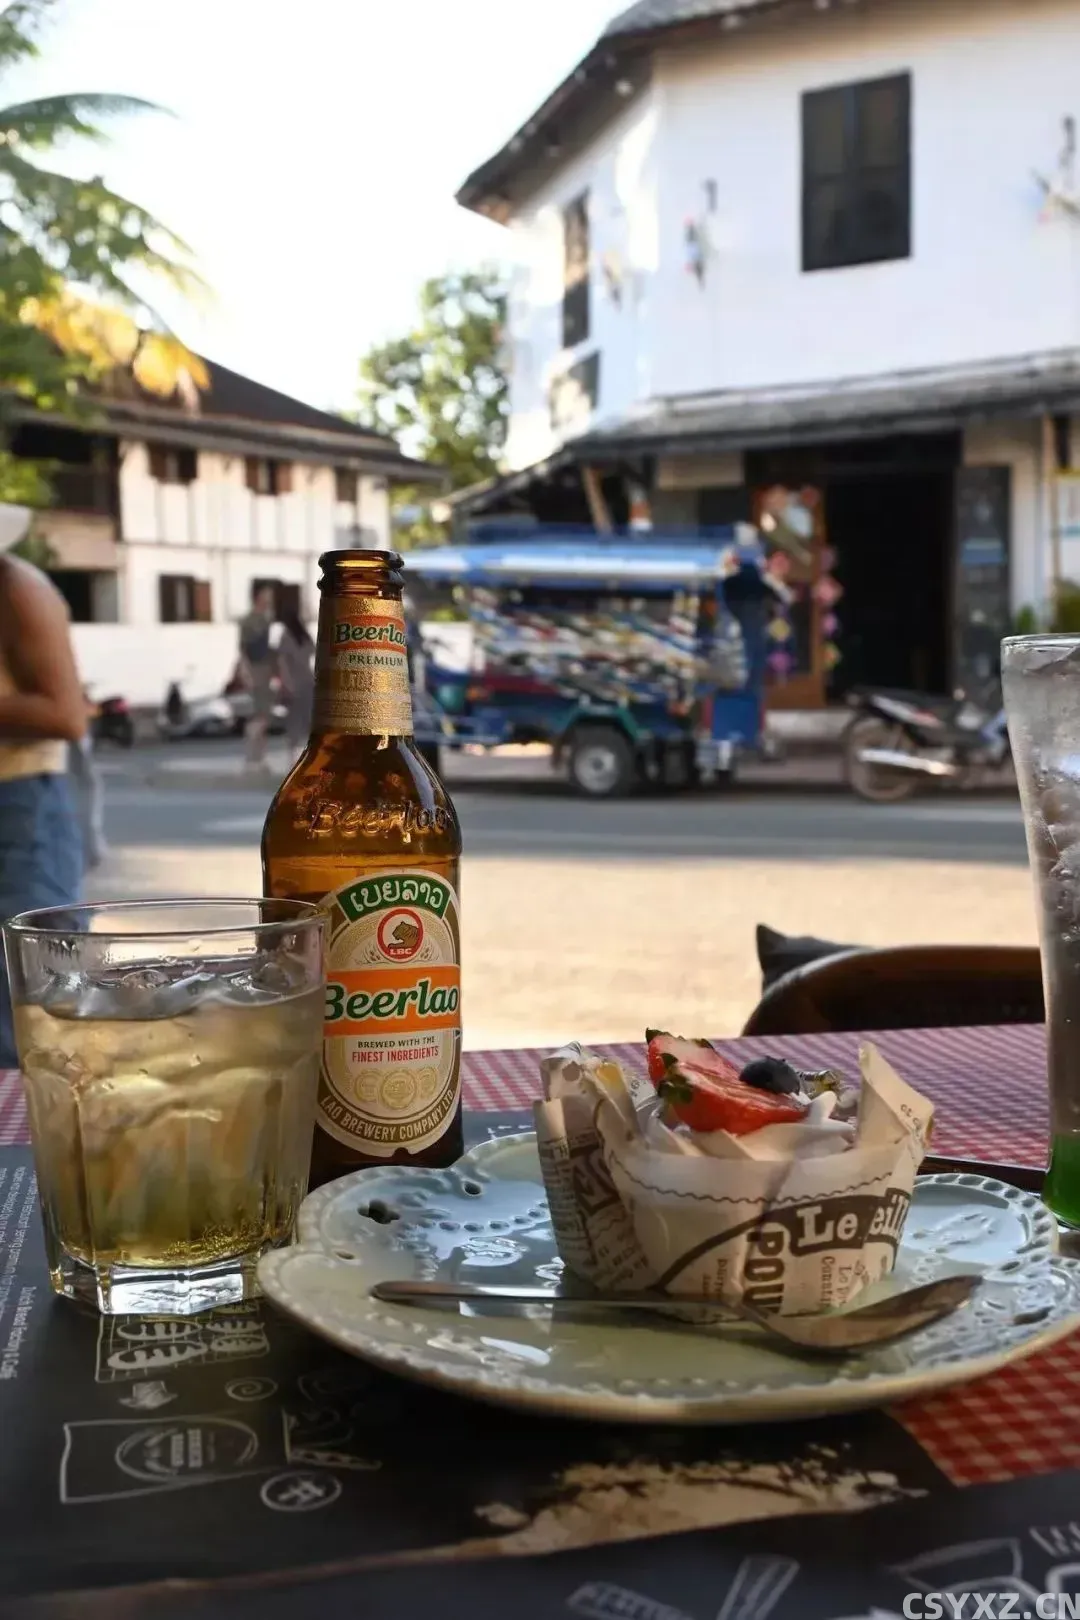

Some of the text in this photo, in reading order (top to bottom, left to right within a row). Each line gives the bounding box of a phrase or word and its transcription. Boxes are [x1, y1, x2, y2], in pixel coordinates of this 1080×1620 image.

[350, 654, 404, 666] PREMIUM
[389, 948, 412, 956] LBC
[325, 977, 459, 1021] Beerlao
[357, 1035, 436, 1049] BREWED WITH THE
[352, 1046, 439, 1063] FINEST INGREDIENTS
[320, 1096, 342, 1121] LAO
[341, 1114, 397, 1140] BREWERY
[399, 1109, 444, 1140] COMPANY
[796, 1206, 859, 1248] Le
